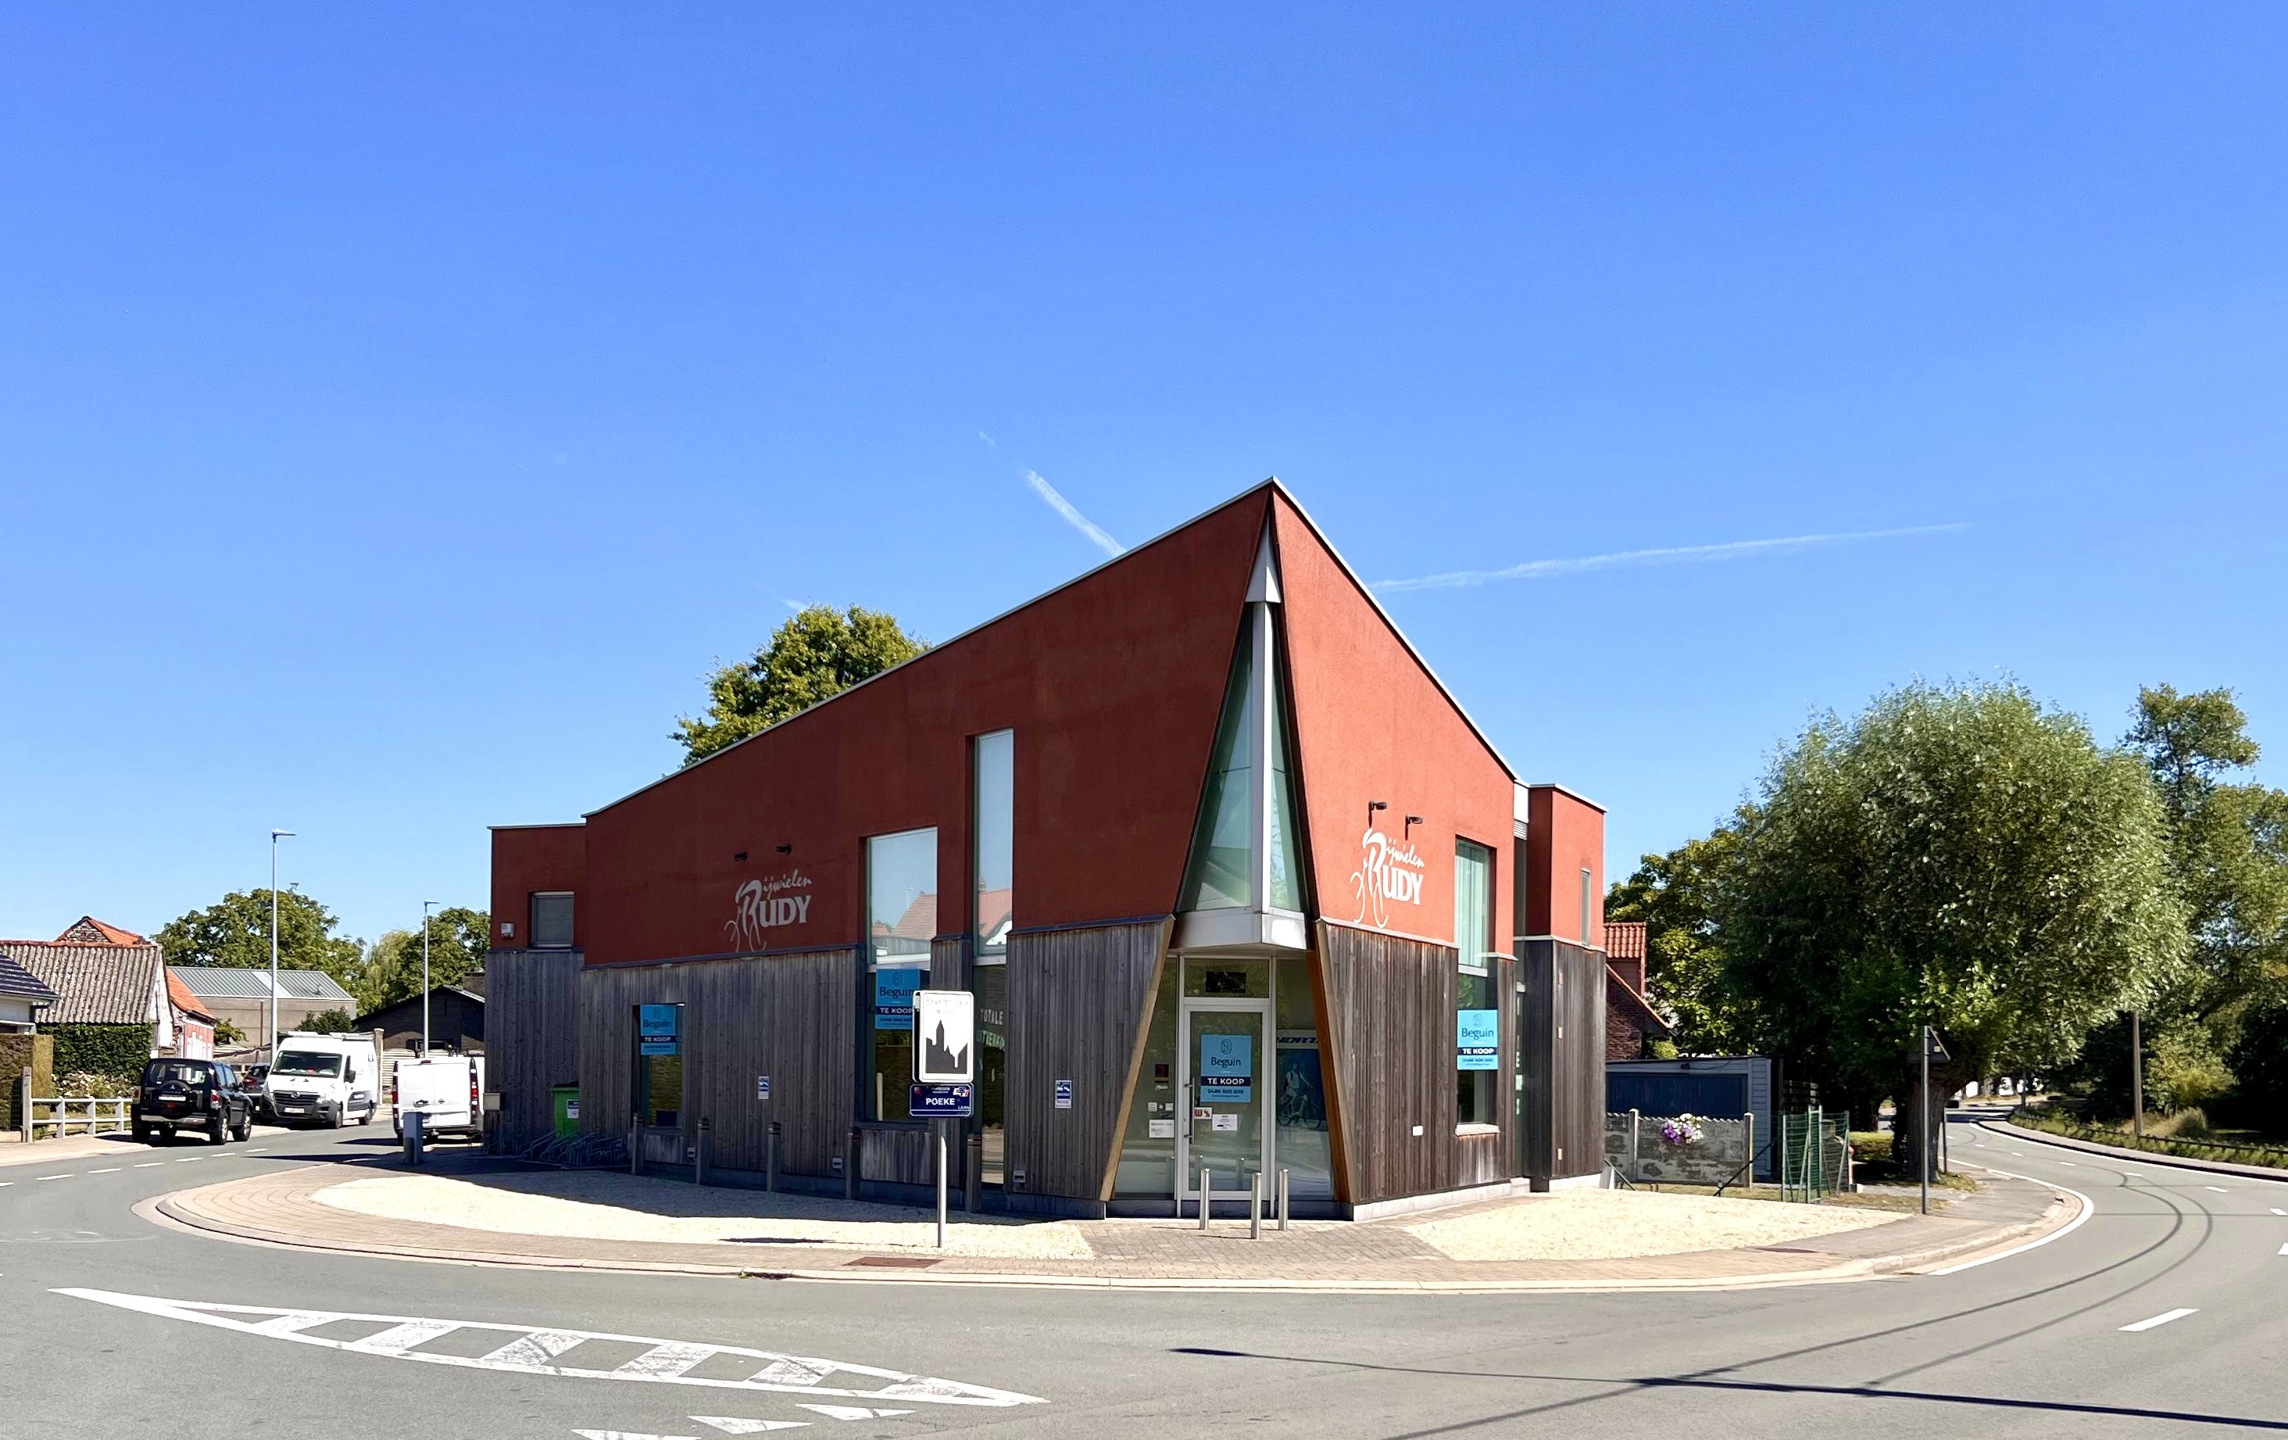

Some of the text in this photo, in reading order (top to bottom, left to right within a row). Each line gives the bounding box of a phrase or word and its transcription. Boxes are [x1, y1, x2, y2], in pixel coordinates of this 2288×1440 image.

[980, 1008, 1004, 1025] TOTALE
[1461, 1027, 1495, 1041] Beguin
[1210, 1056, 1242, 1069] Beguin
[1207, 1077, 1218, 1085] TE
[925, 1098, 955, 1106] POEKE
